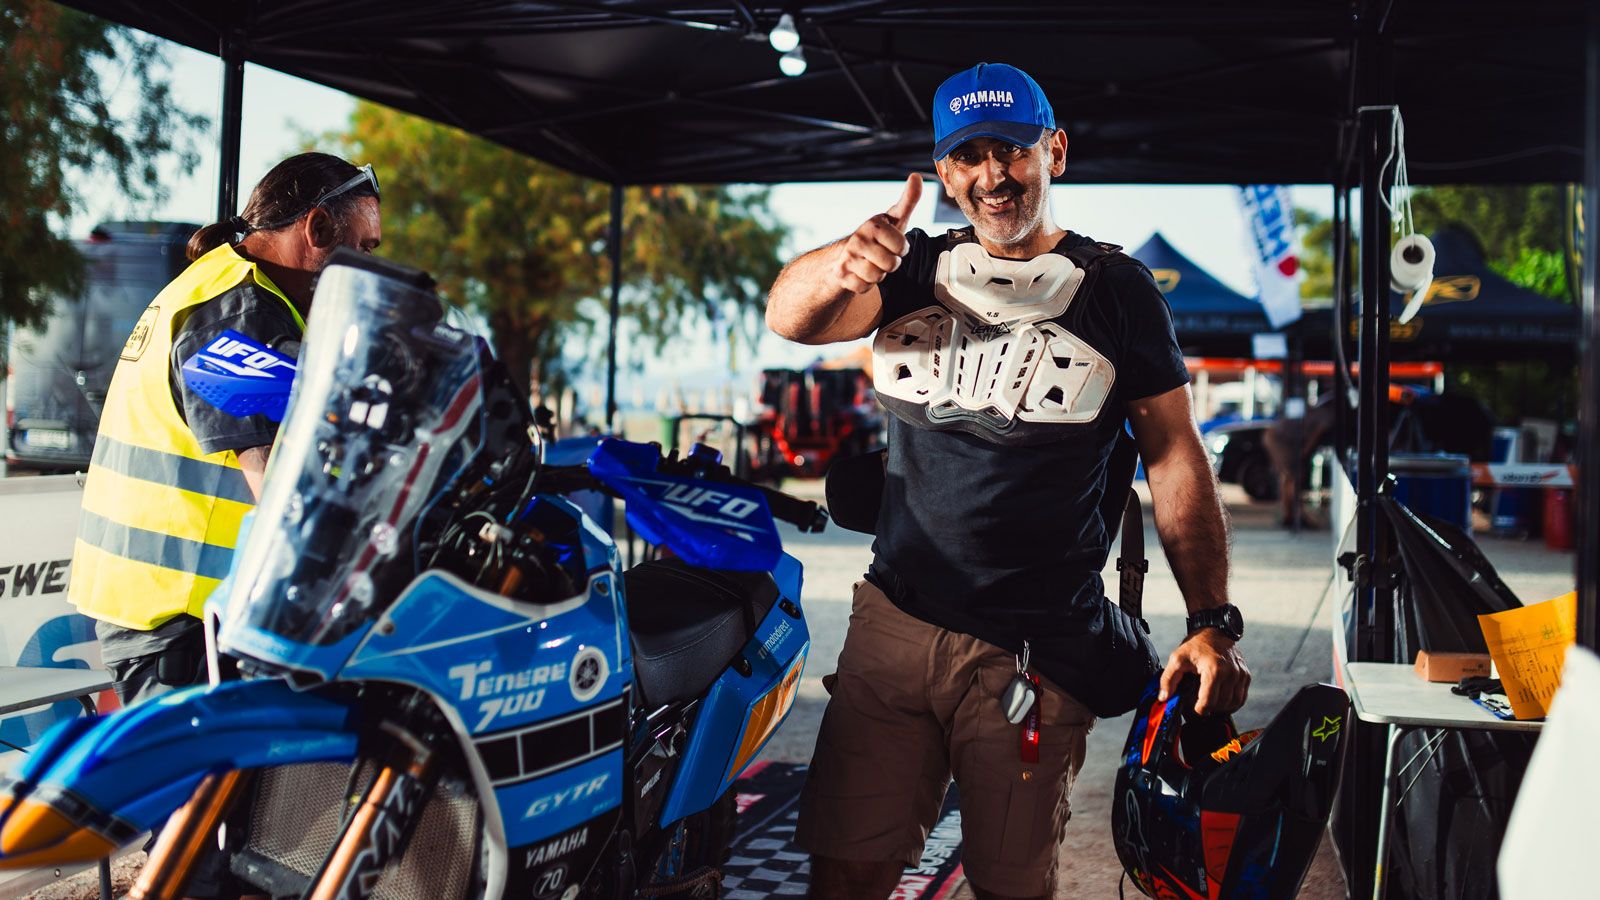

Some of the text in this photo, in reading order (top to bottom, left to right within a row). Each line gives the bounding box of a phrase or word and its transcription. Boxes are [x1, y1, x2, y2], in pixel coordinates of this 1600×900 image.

[954, 103, 1011, 115] RACING
[962, 90, 1014, 106] YAMAHA
[206, 336, 279, 370] UFO
[664, 484, 760, 519] UFO
[474, 688, 546, 733] 700
[523, 772, 611, 819] GYTR
[525, 827, 589, 869] YAMAHA
[538, 867, 563, 896] 70
